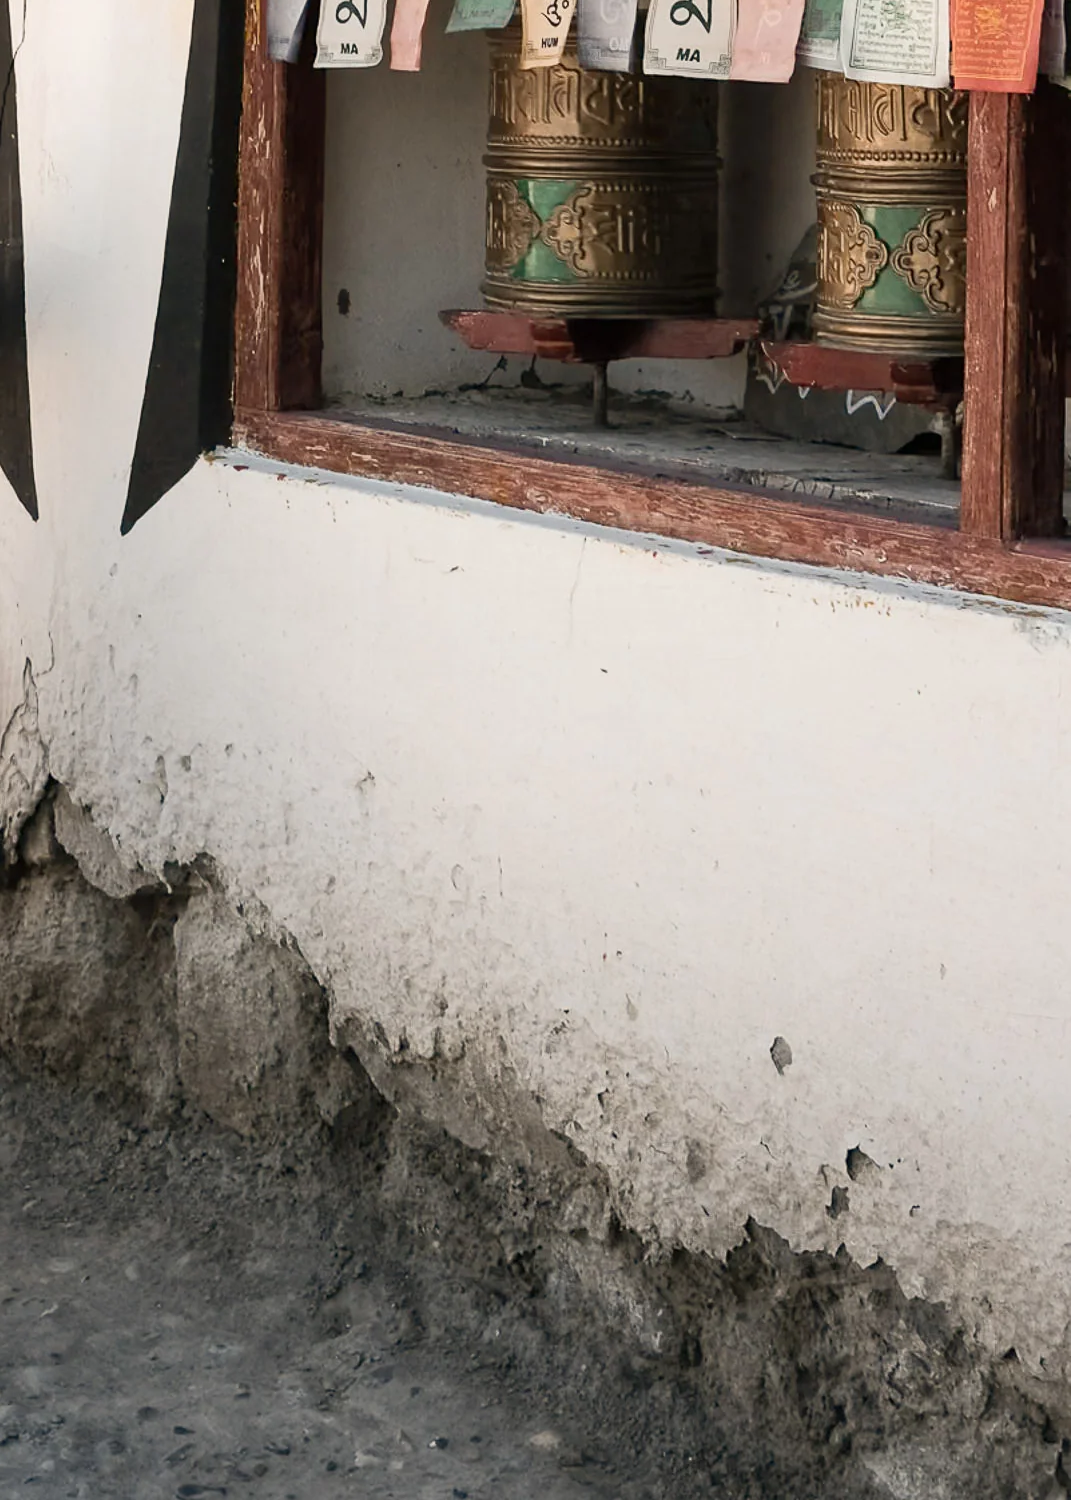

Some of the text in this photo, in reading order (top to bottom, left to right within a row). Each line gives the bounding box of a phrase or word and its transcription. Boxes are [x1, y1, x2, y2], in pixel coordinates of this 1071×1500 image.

[340, 43, 359, 55] MA
[541, 37, 559, 49] HUM
[676, 48, 701, 62] MA
